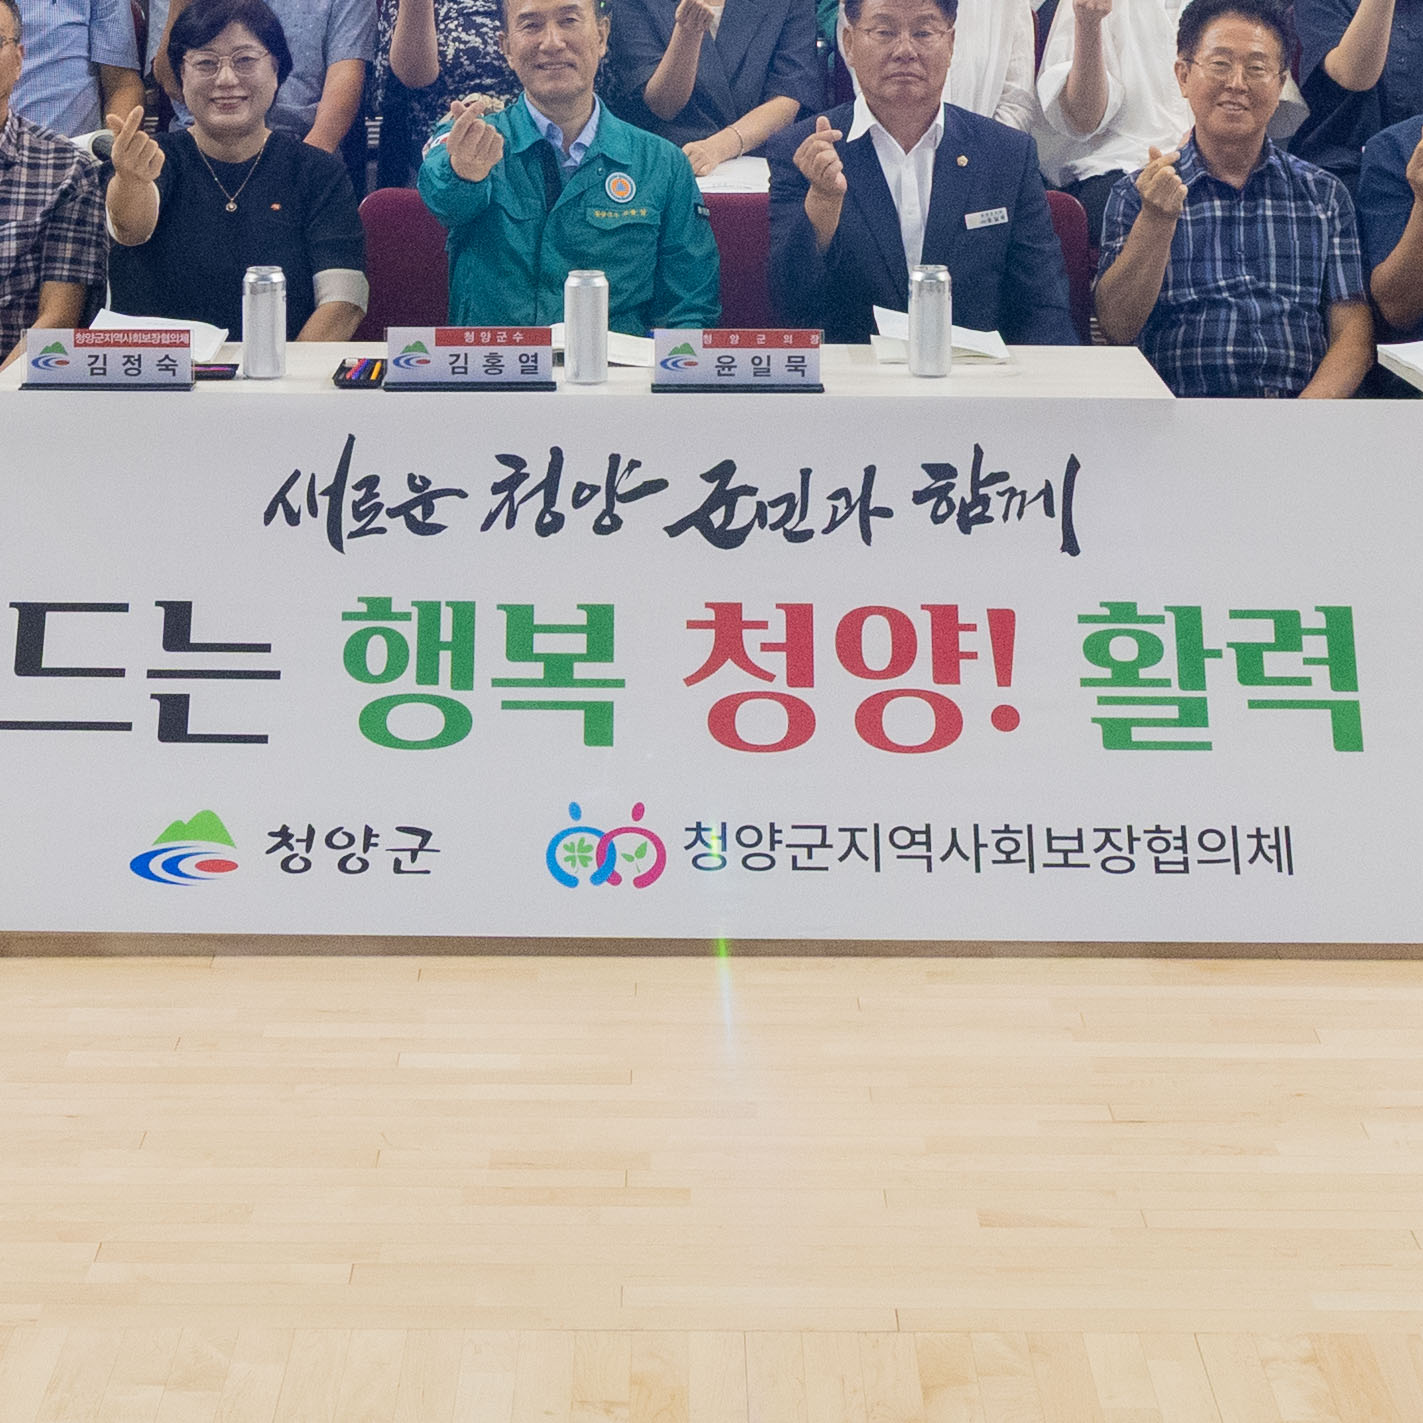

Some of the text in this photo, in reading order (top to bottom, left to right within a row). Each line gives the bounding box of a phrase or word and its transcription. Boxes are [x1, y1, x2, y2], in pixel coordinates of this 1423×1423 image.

[464, 331, 524, 343] 청양군수
[87, 353, 178, 377] 김정숙
[448, 352, 539, 376] 김홍열
[715, 354, 807, 378] 윤일묵
[263, 434, 1082, 558] 새로운 청양 군민과 함께
[342, 597, 627, 751] 행복
[683, 603, 1022, 755] 청양!
[1078, 602, 1365, 753] 활력
[266, 824, 442, 876] 청양군
[681, 822, 1295, 877] 청양군지역사회보장협의체
